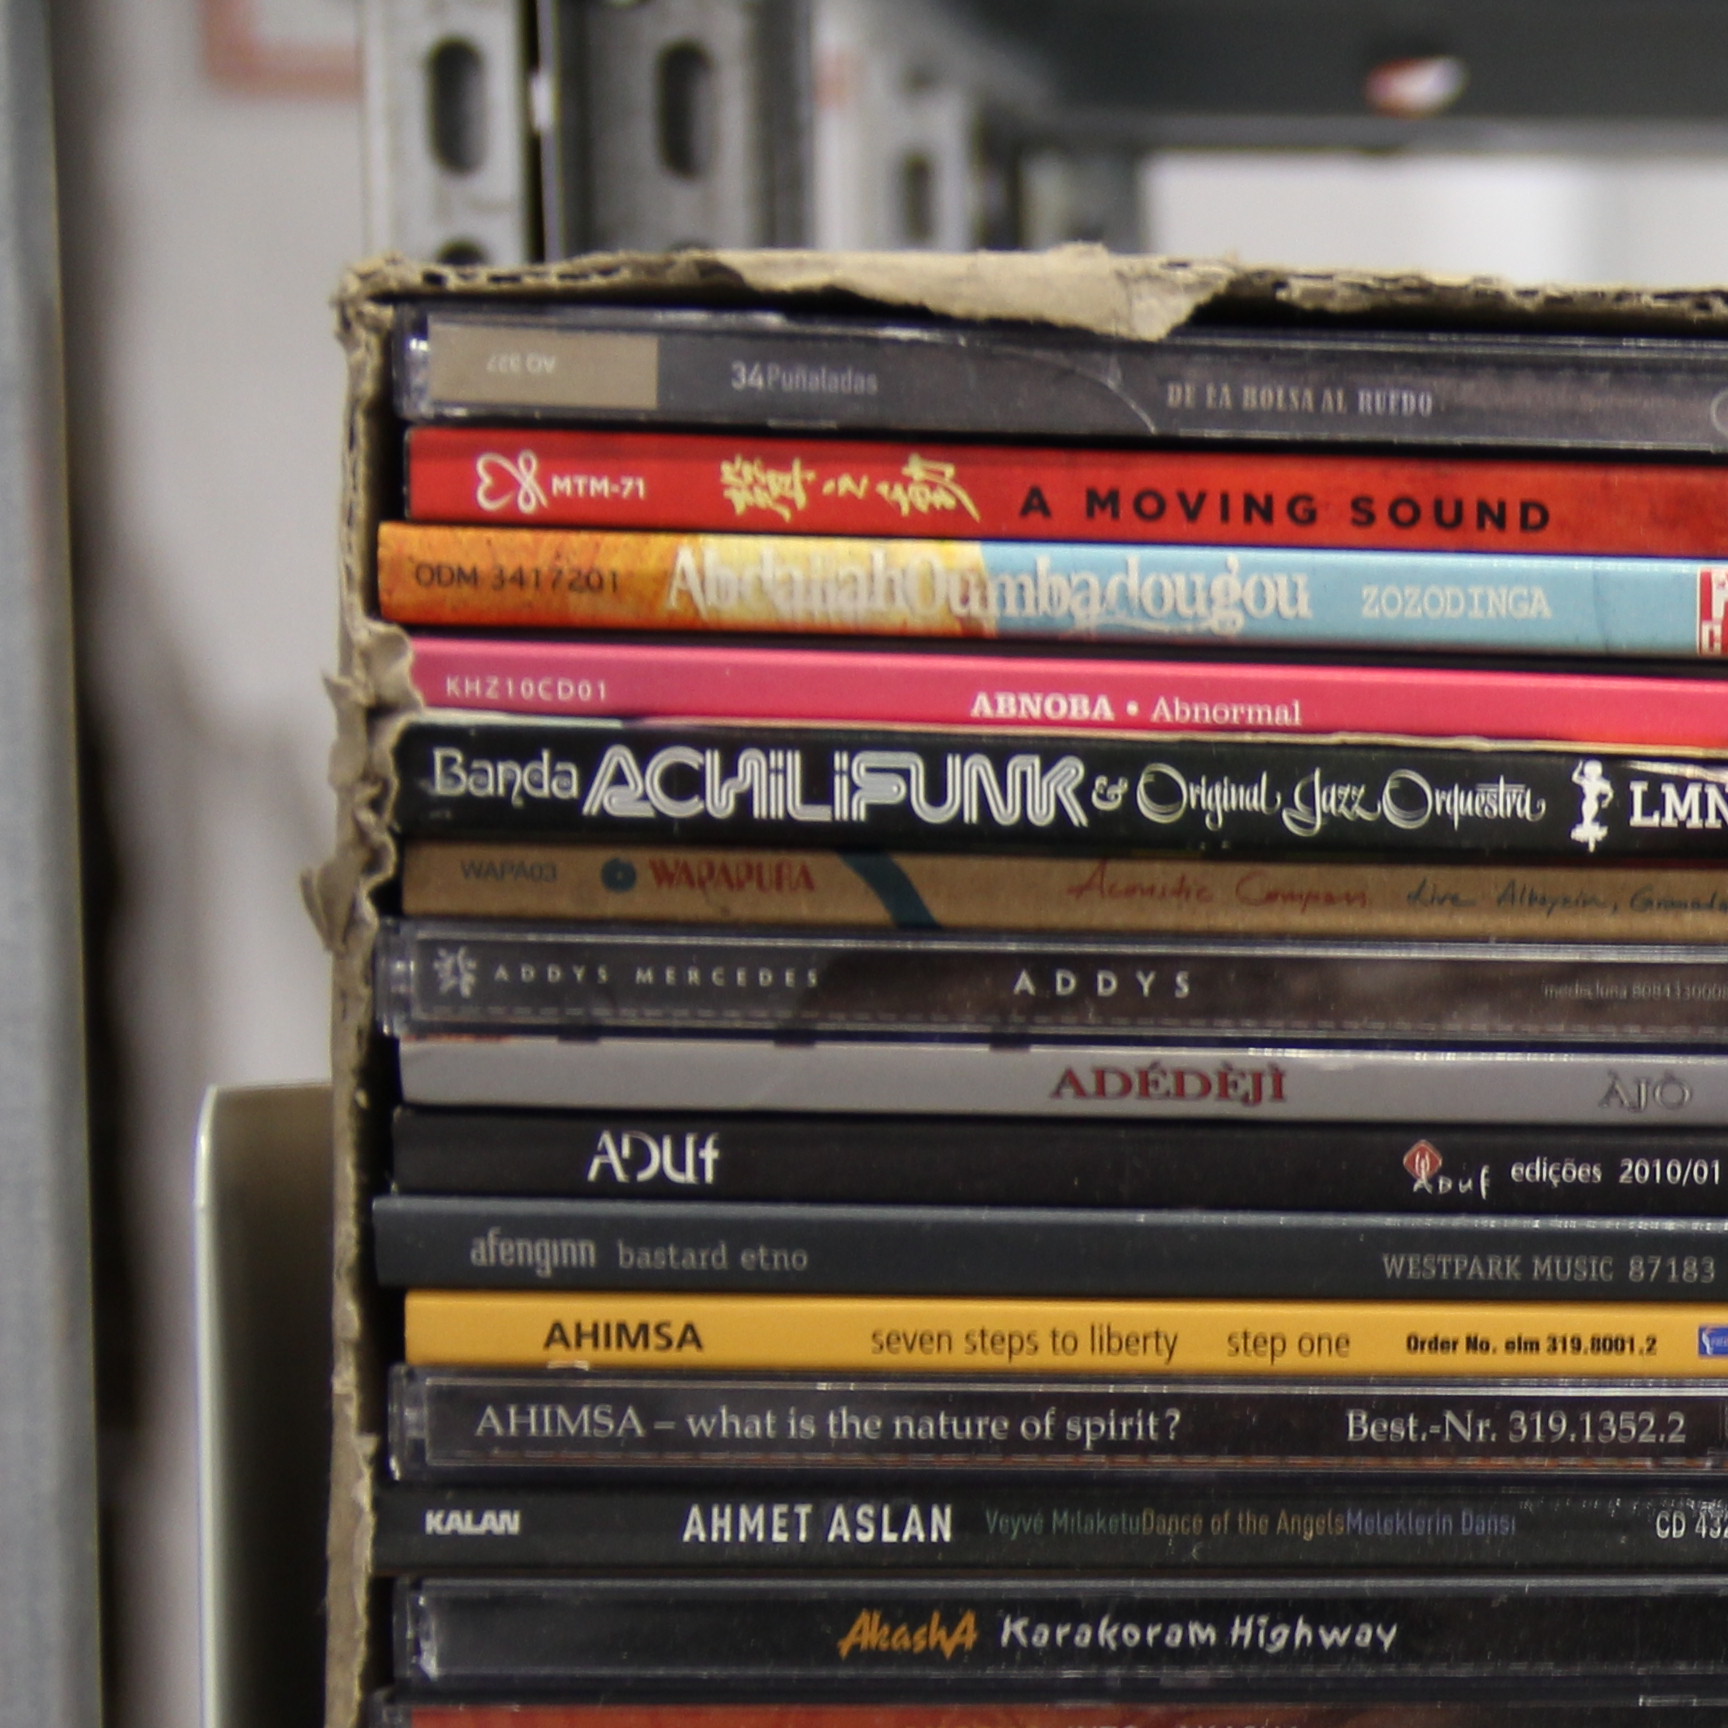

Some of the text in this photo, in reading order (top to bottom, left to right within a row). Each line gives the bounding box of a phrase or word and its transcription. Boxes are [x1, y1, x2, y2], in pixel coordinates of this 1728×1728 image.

[551, 475, 646, 499] MTM-71
[1019, 488, 1550, 532] A MOVING SOUND
[1361, 585, 1551, 620] ZOZODINGA
[971, 691, 1301, 726] ABNOBA Abnormal
[432, 749, 579, 807] Banda
[1136, 761, 1281, 831] Original
[1282, 768, 1381, 836] Jazz
[1382, 768, 1546, 831] Orquestra
[495, 965, 818, 988] ADDYS MERCEDES
[1511, 1158, 1722, 1186] edições 2010/01
[618, 1240, 729, 1270] bastard
[740, 1246, 808, 1271] etno
[1382, 1255, 1716, 1282] WESTPARK MUSIC 87183
[544, 1322, 1351, 1365] AHIMSA seven steps to liberty step one
[1508, 1410, 1686, 1445] 319.1352.2
[425, 1510, 520, 1535] KALAN
[682, 1505, 952, 1542] AHMET ASLAN
